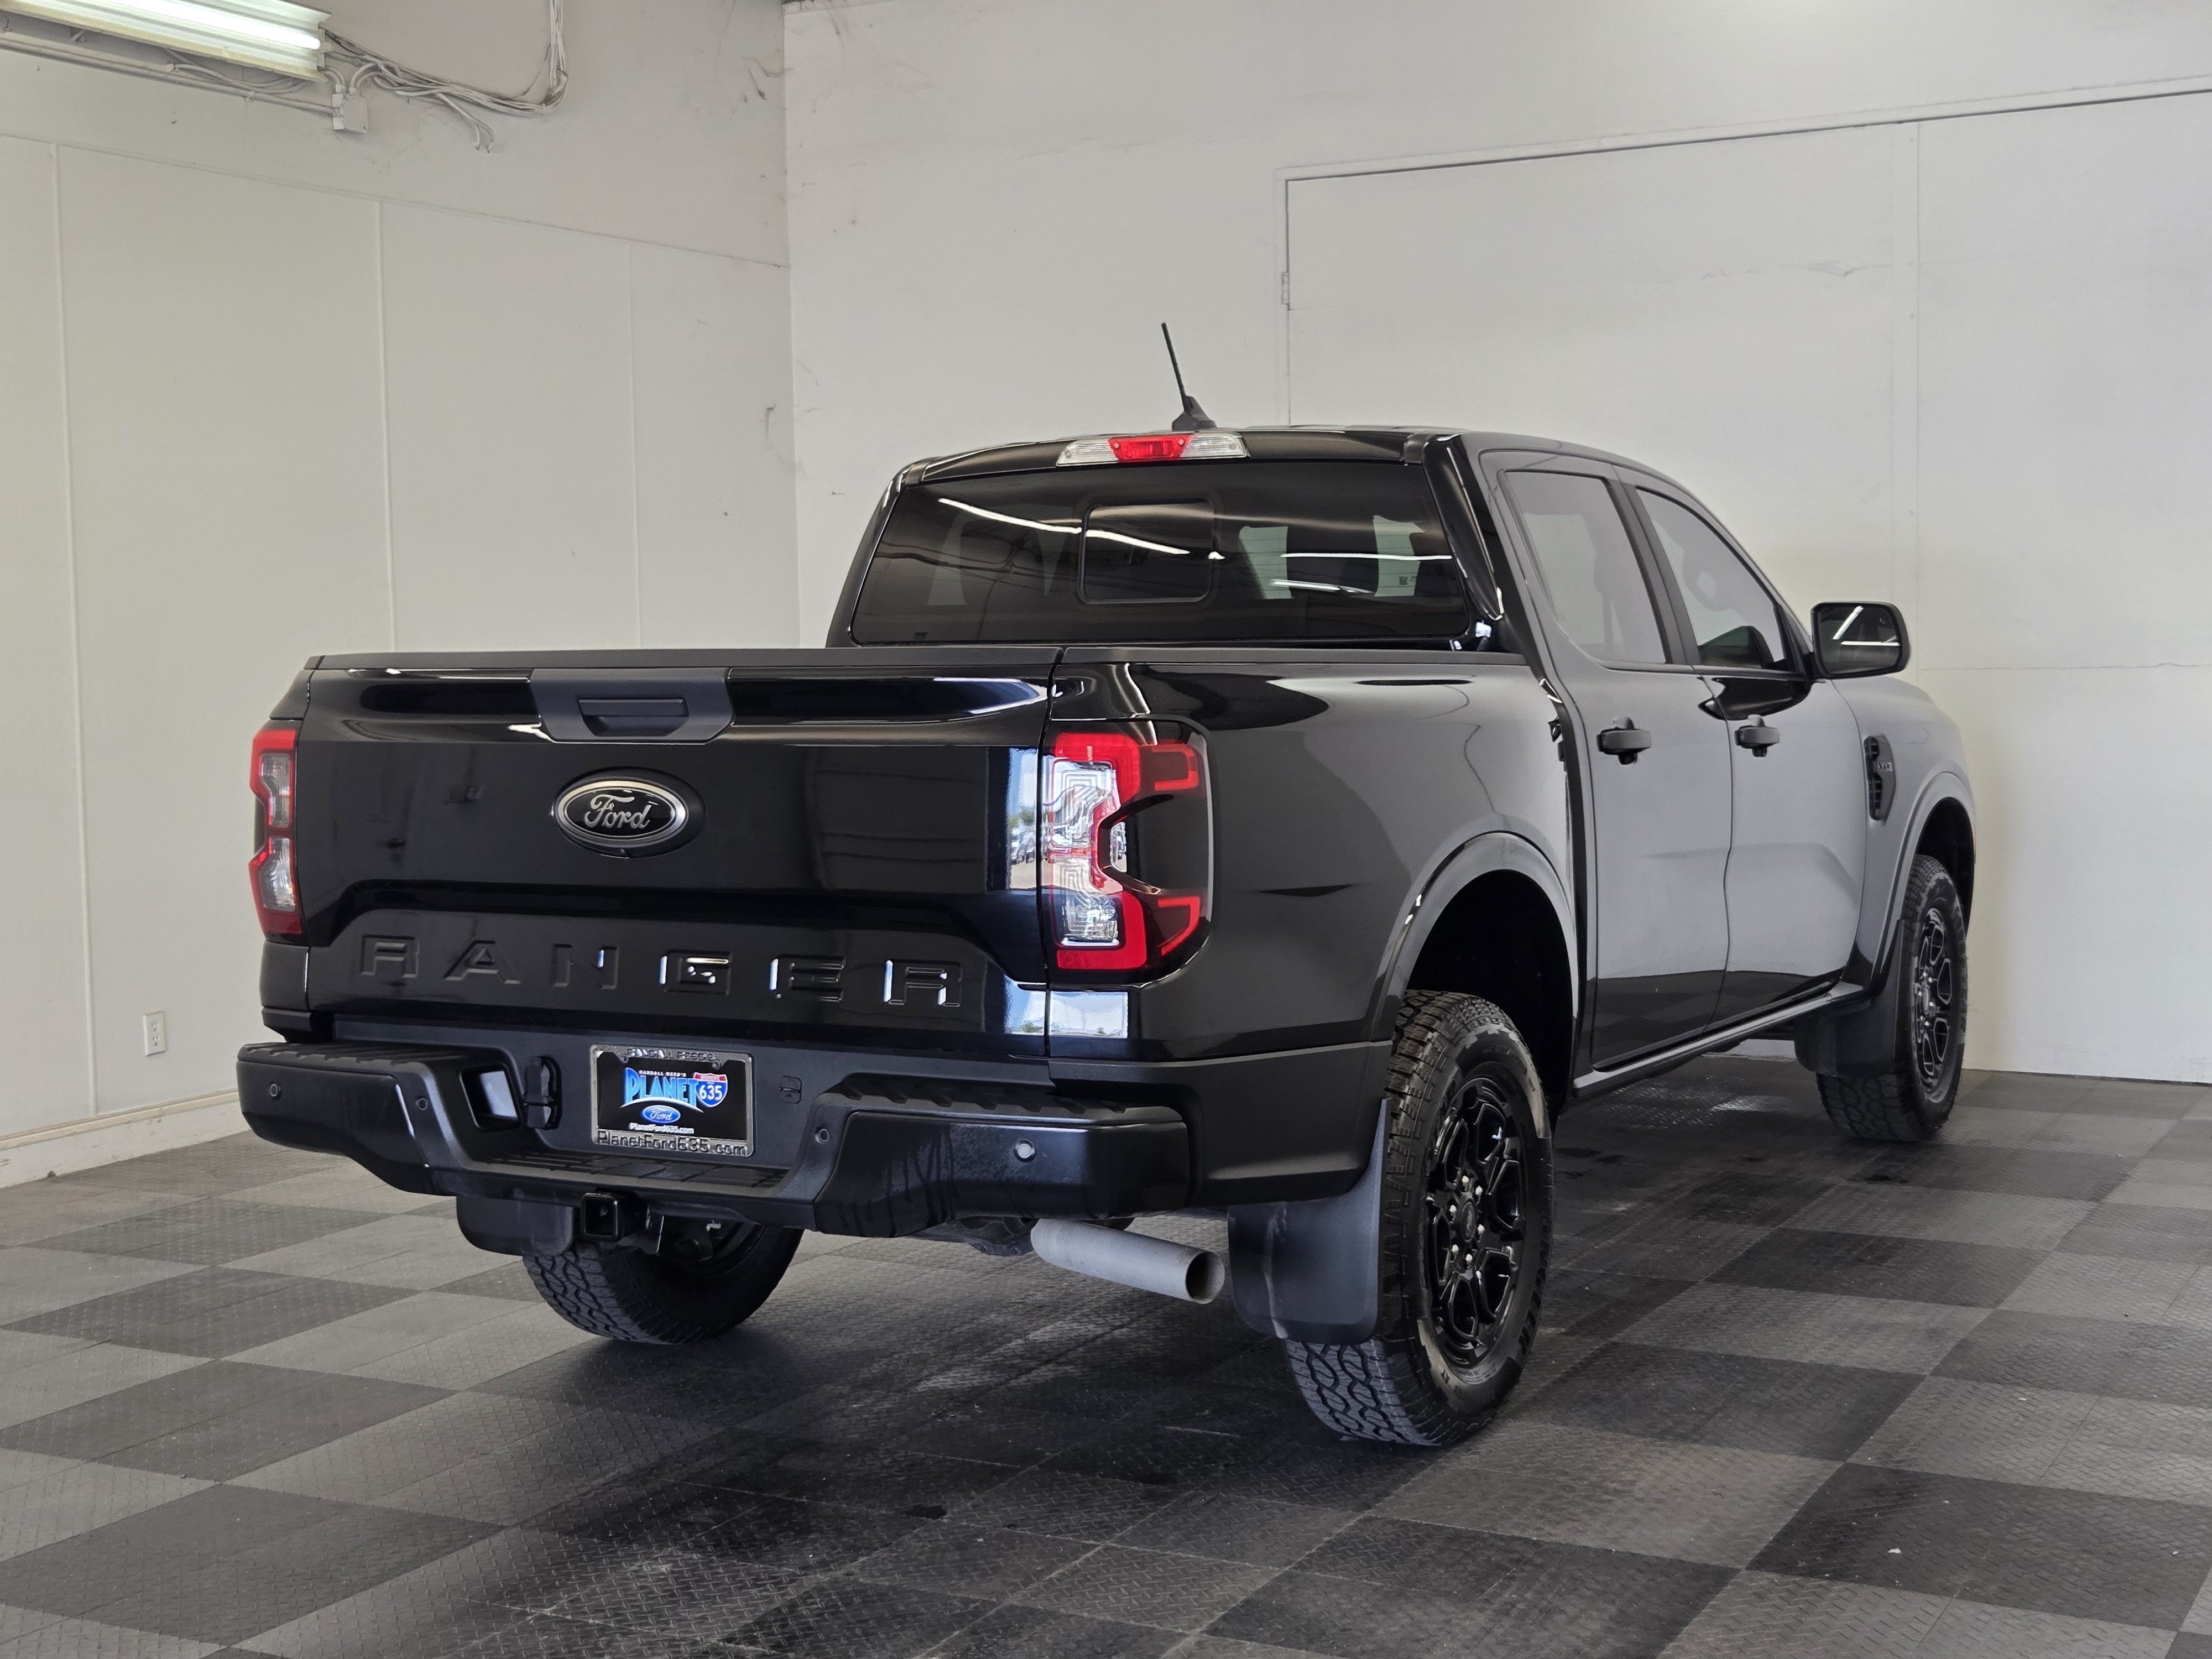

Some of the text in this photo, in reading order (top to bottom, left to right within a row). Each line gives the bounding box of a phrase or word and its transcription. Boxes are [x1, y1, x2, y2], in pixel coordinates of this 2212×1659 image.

[585, 794, 651, 828] Ford
[360, 933, 963, 1009] RANGER
[624, 1067, 722, 1107] PLANET 635
[650, 1108, 674, 1121] Ford
[597, 1130, 748, 1156] PlanetFord635.com
